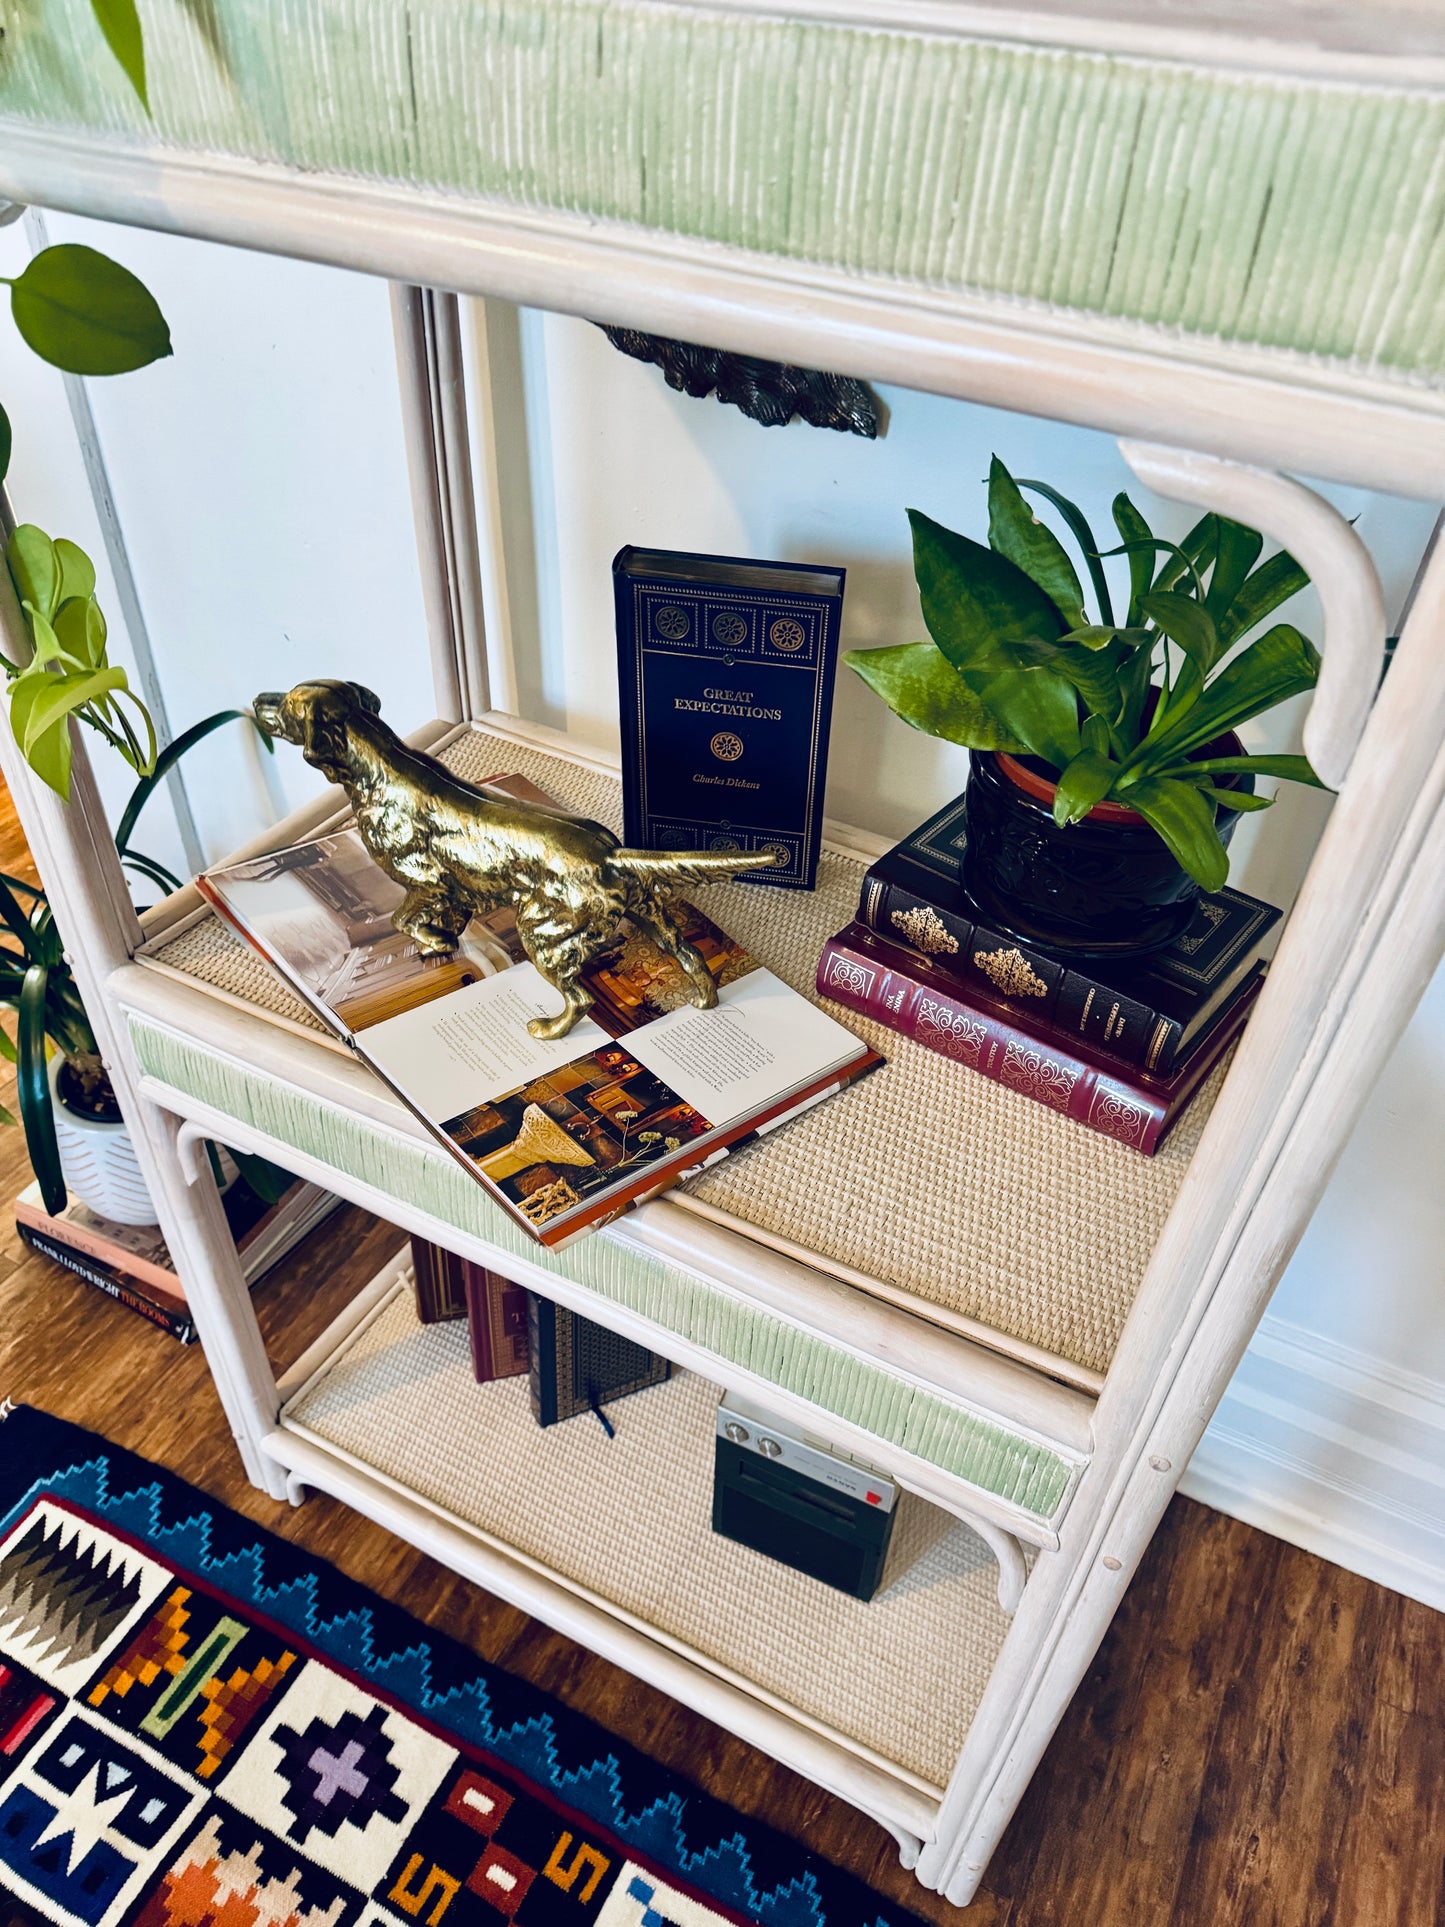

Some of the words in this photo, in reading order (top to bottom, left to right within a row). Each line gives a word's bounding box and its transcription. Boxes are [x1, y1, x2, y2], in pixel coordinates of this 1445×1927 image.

[703, 688, 754, 703] GREAT
[674, 698, 782, 720] EXPECTATIONS
[692, 774, 725, 786] Charles
[725, 778, 761, 790] Dickens
[987, 1040, 999, 1069] TOLSTOY
[32, 1237, 60, 1261] FRANK
